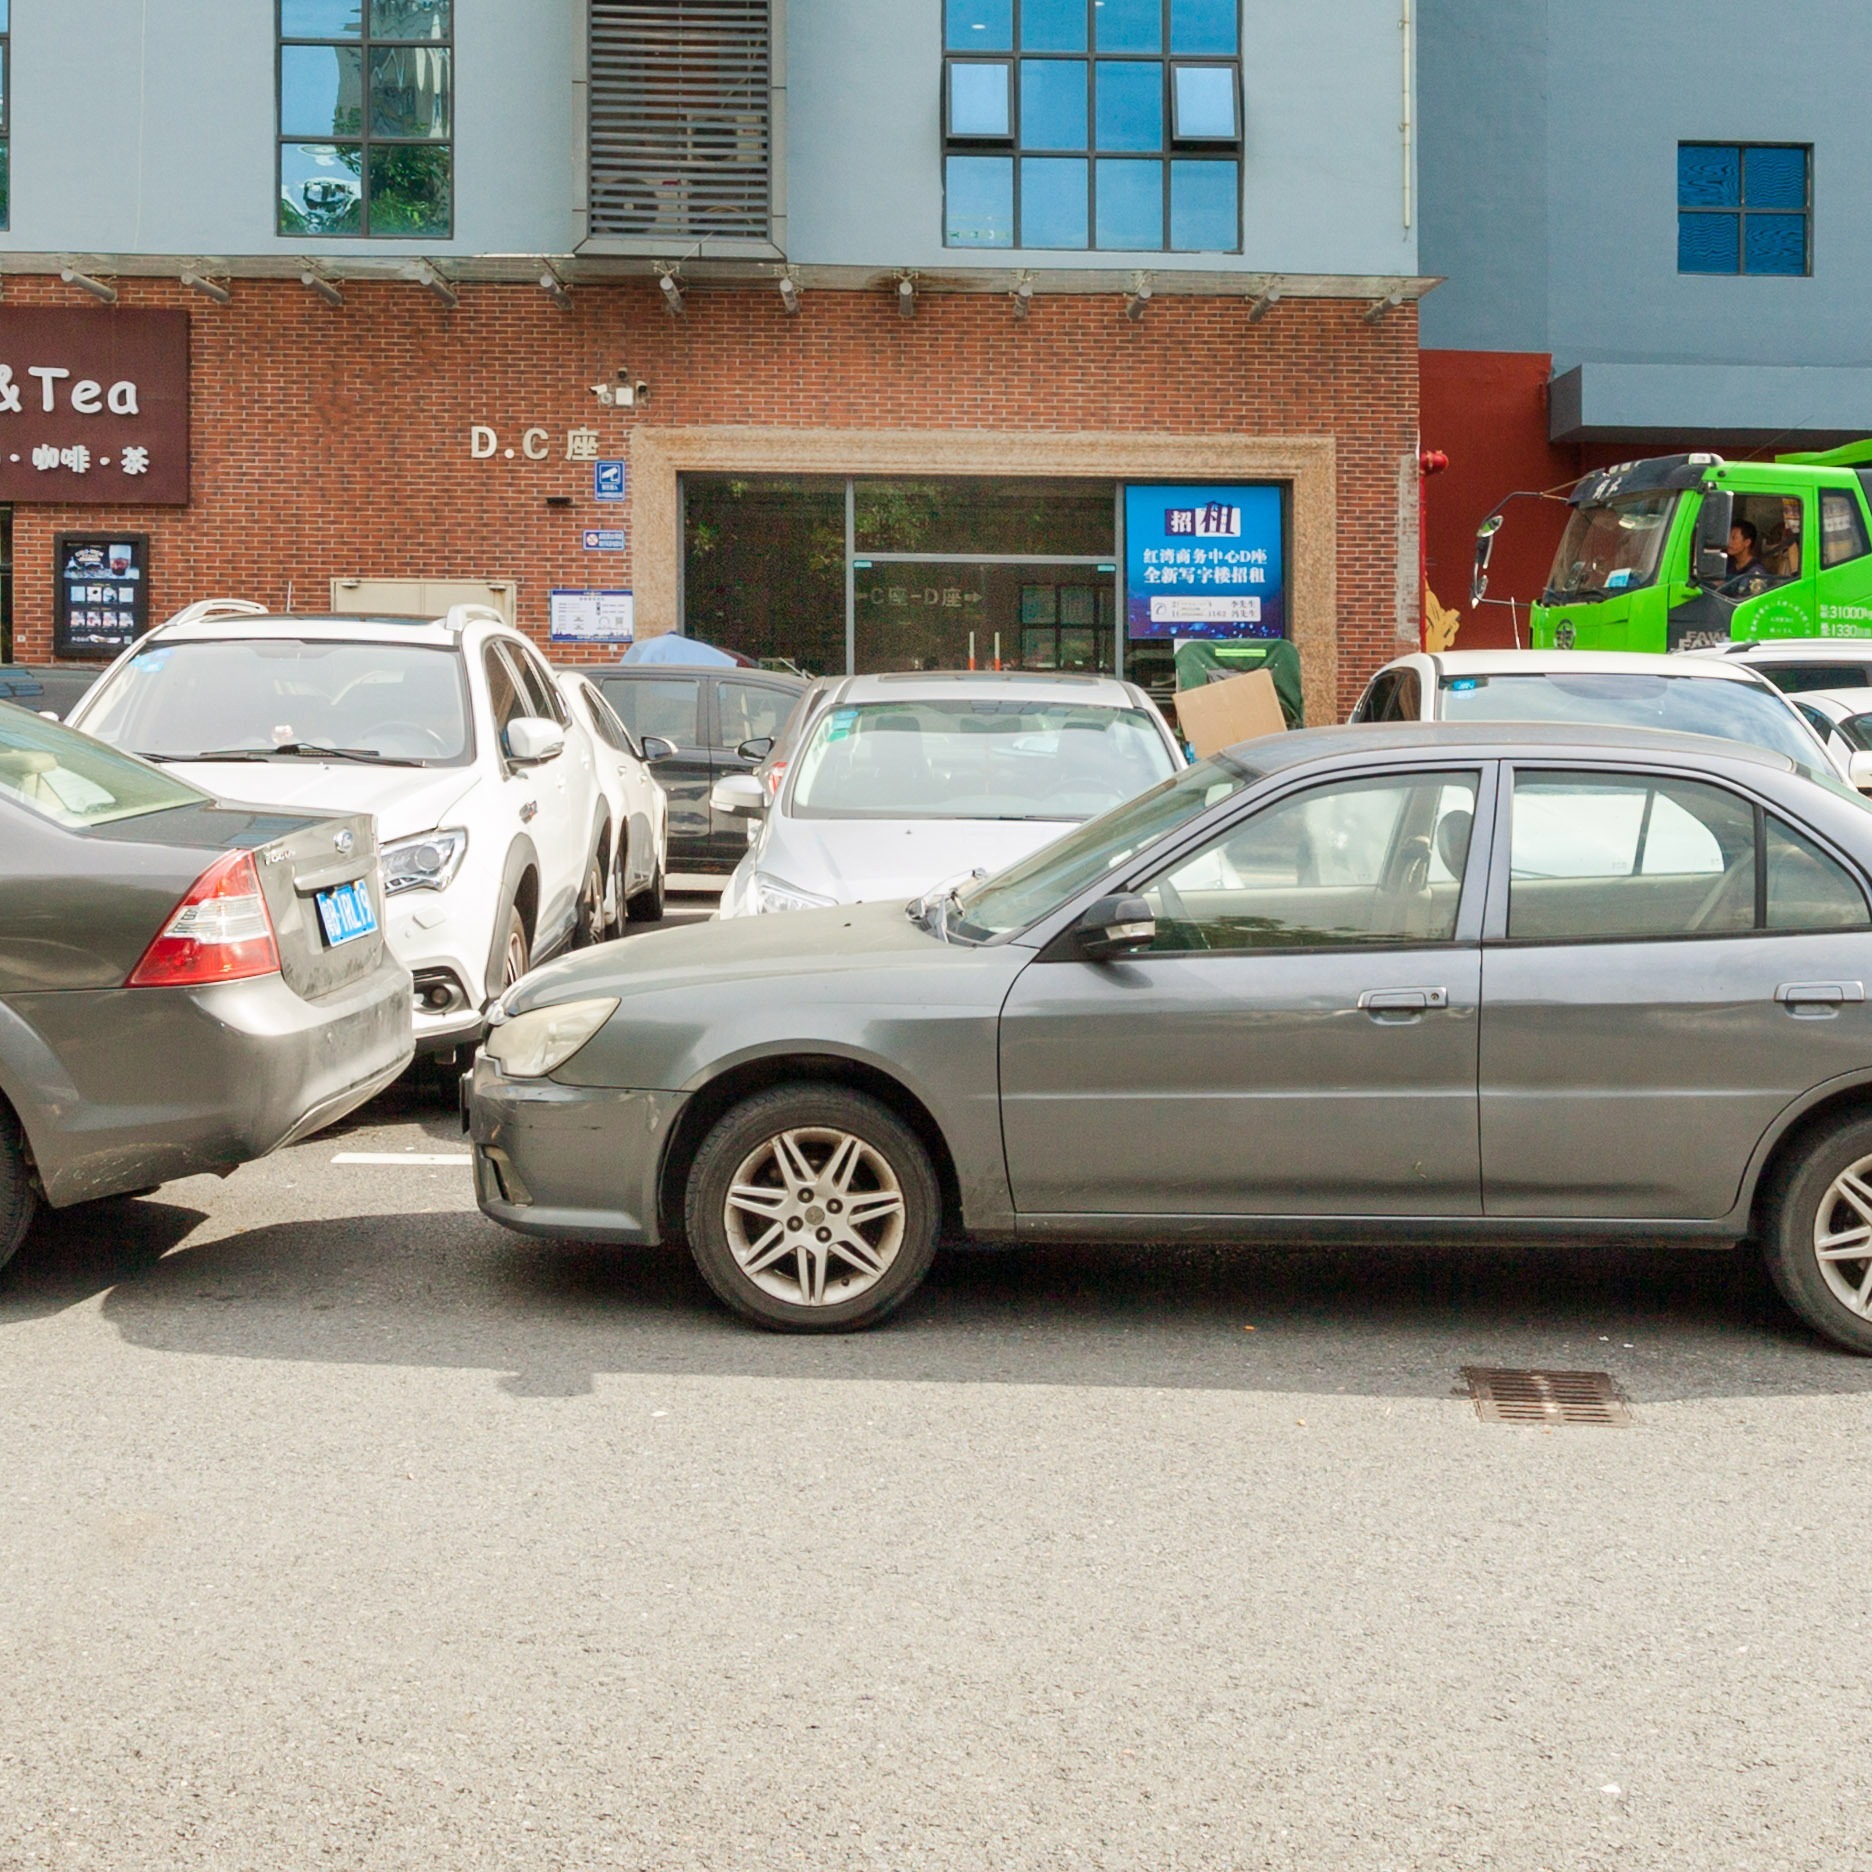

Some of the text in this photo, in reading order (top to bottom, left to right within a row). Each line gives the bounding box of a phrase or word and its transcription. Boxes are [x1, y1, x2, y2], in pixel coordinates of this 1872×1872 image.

[1170, 501, 1236, 536] 招租
[1143, 548, 1268, 565] 红湾商务中心D座
[1143, 566, 1266, 584] 全新写字楼招租
